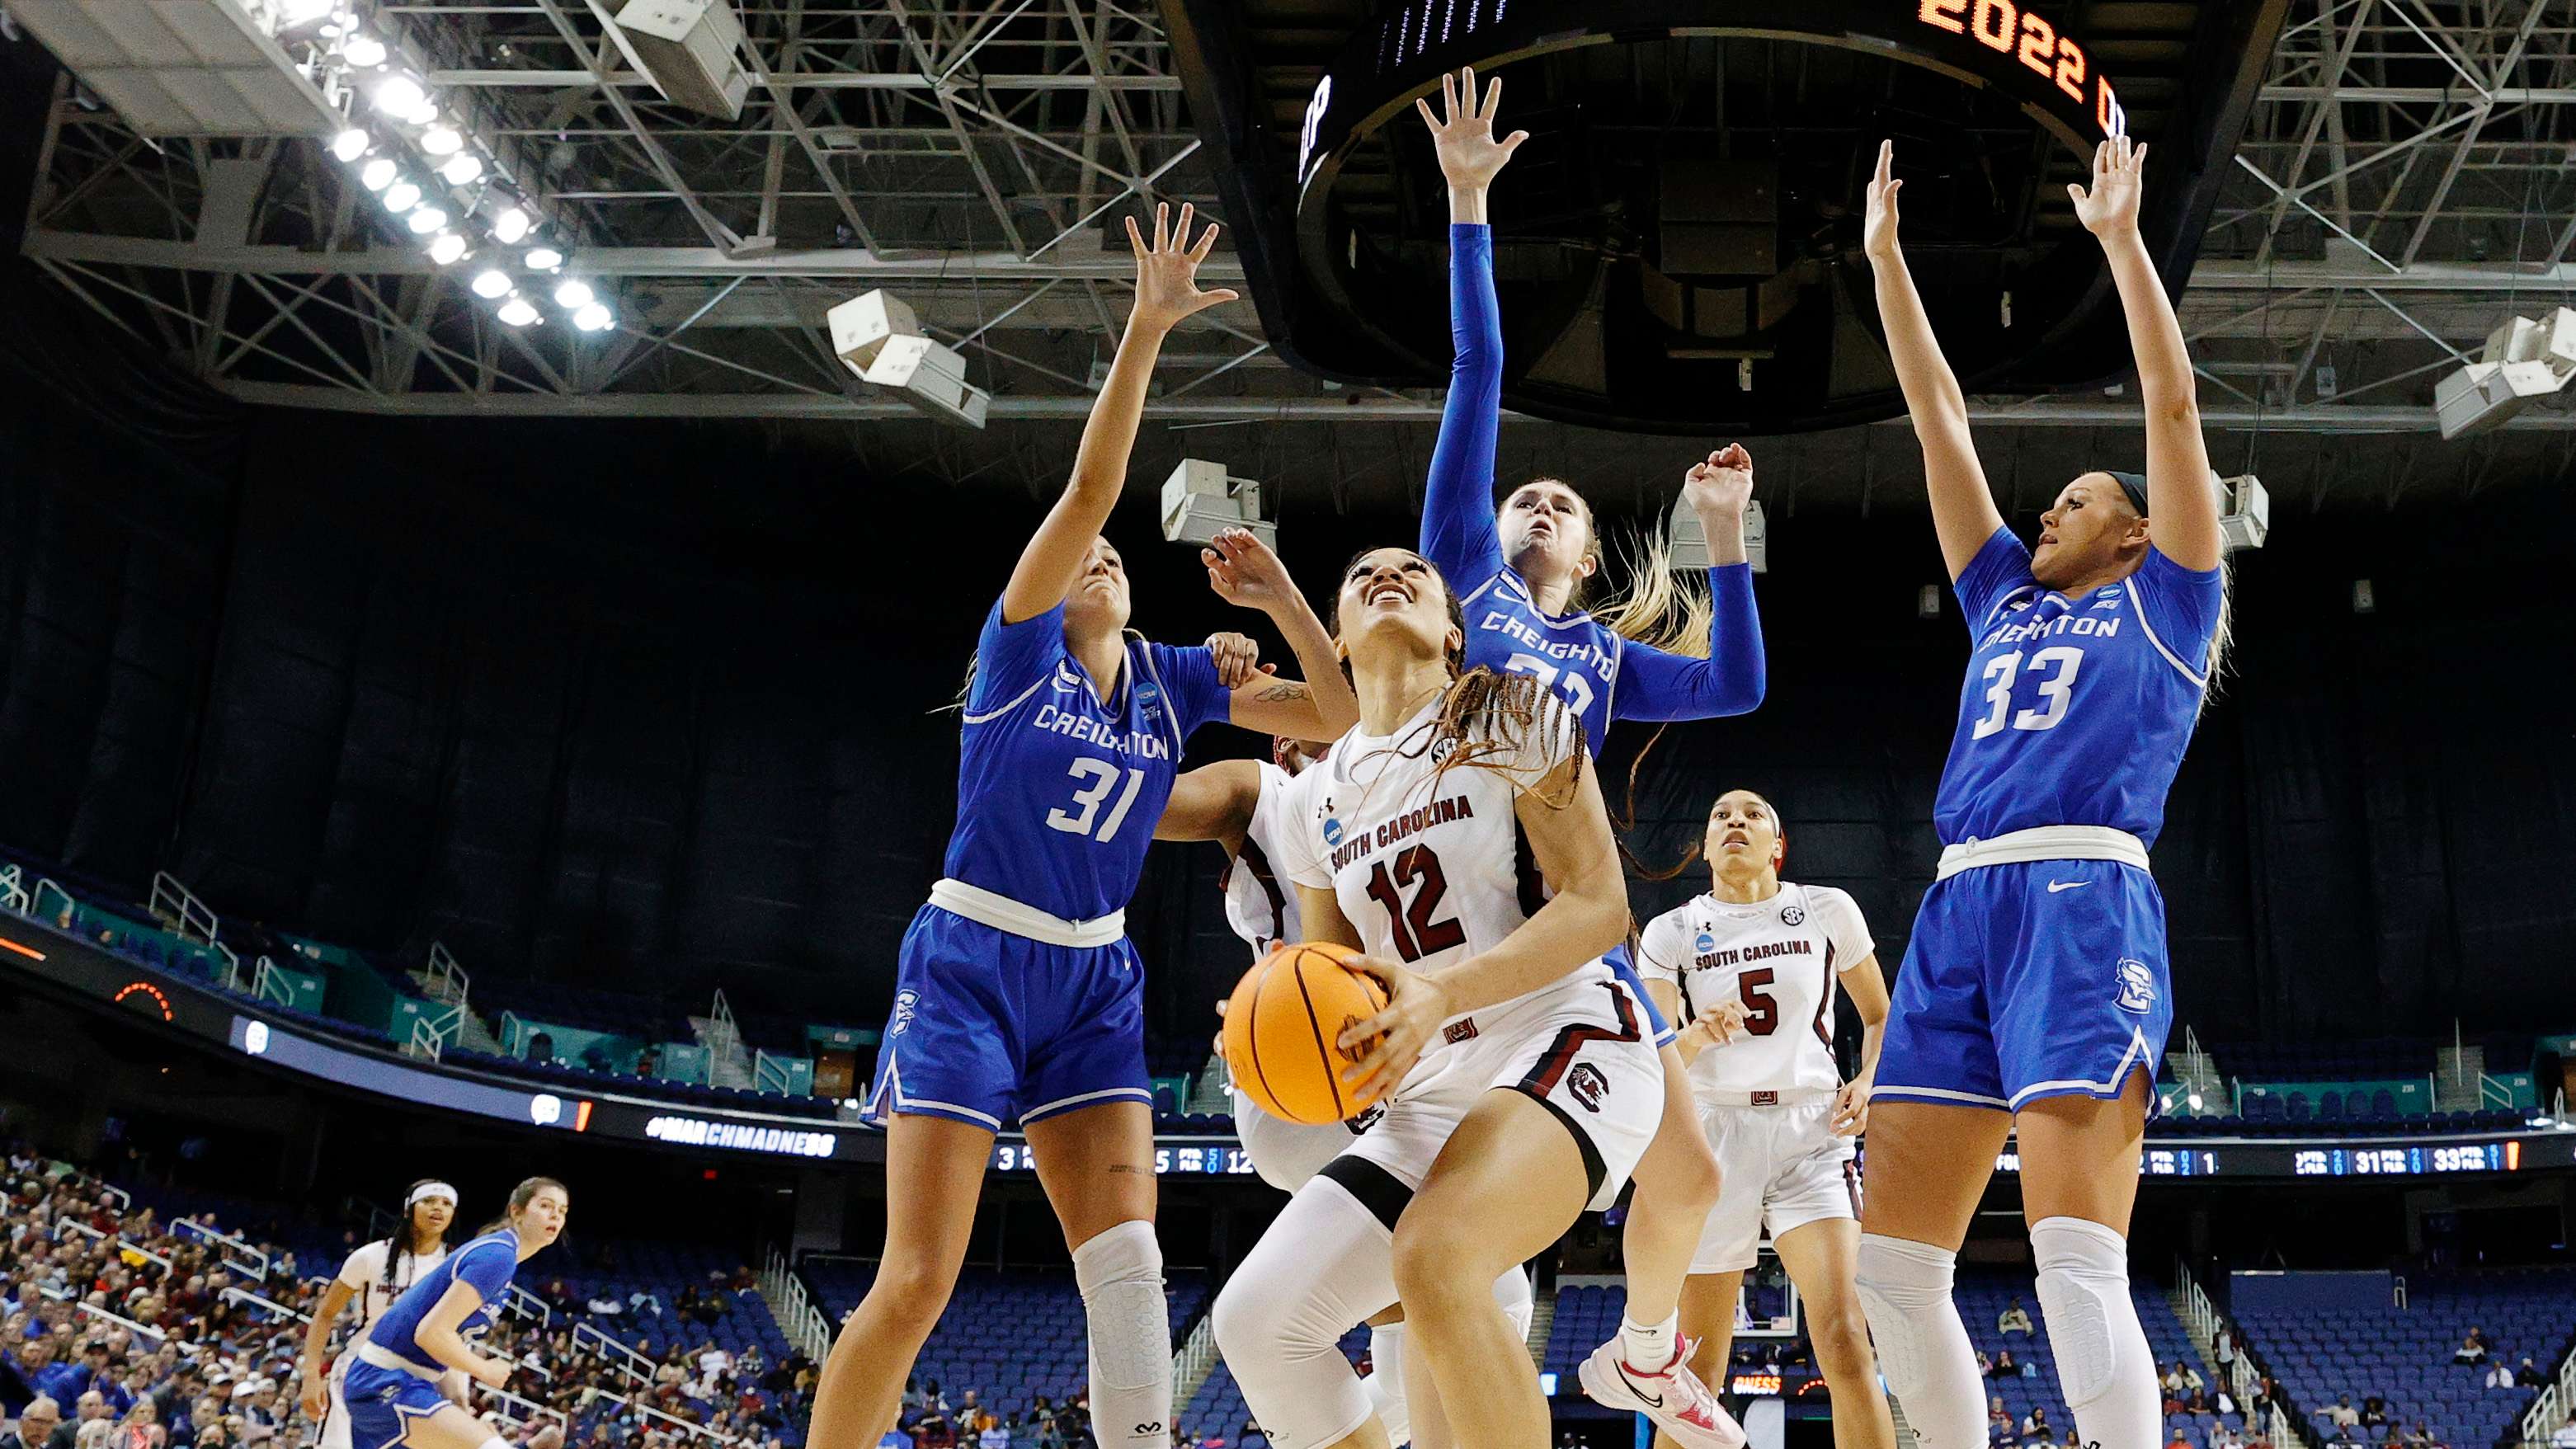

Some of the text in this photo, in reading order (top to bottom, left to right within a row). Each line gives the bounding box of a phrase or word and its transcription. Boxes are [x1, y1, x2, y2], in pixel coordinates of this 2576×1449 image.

[1972, 647, 2085, 740] 33
[1046, 757, 1145, 844] 31
[1331, 795, 1474, 873] SOUTH CAROLINA
[1365, 843, 1467, 964] 12
[1782, 907, 1804, 925] SEC
[1695, 940, 1812, 971] SOUTH CAROLINA
[1738, 967, 1778, 1037] 5
[646, 1117, 836, 1157] #MARCHMADNESS
[1227, 1150, 1254, 1174] 12
[2356, 1152, 2379, 1174] 31
[2434, 1149, 2461, 1171] 33
